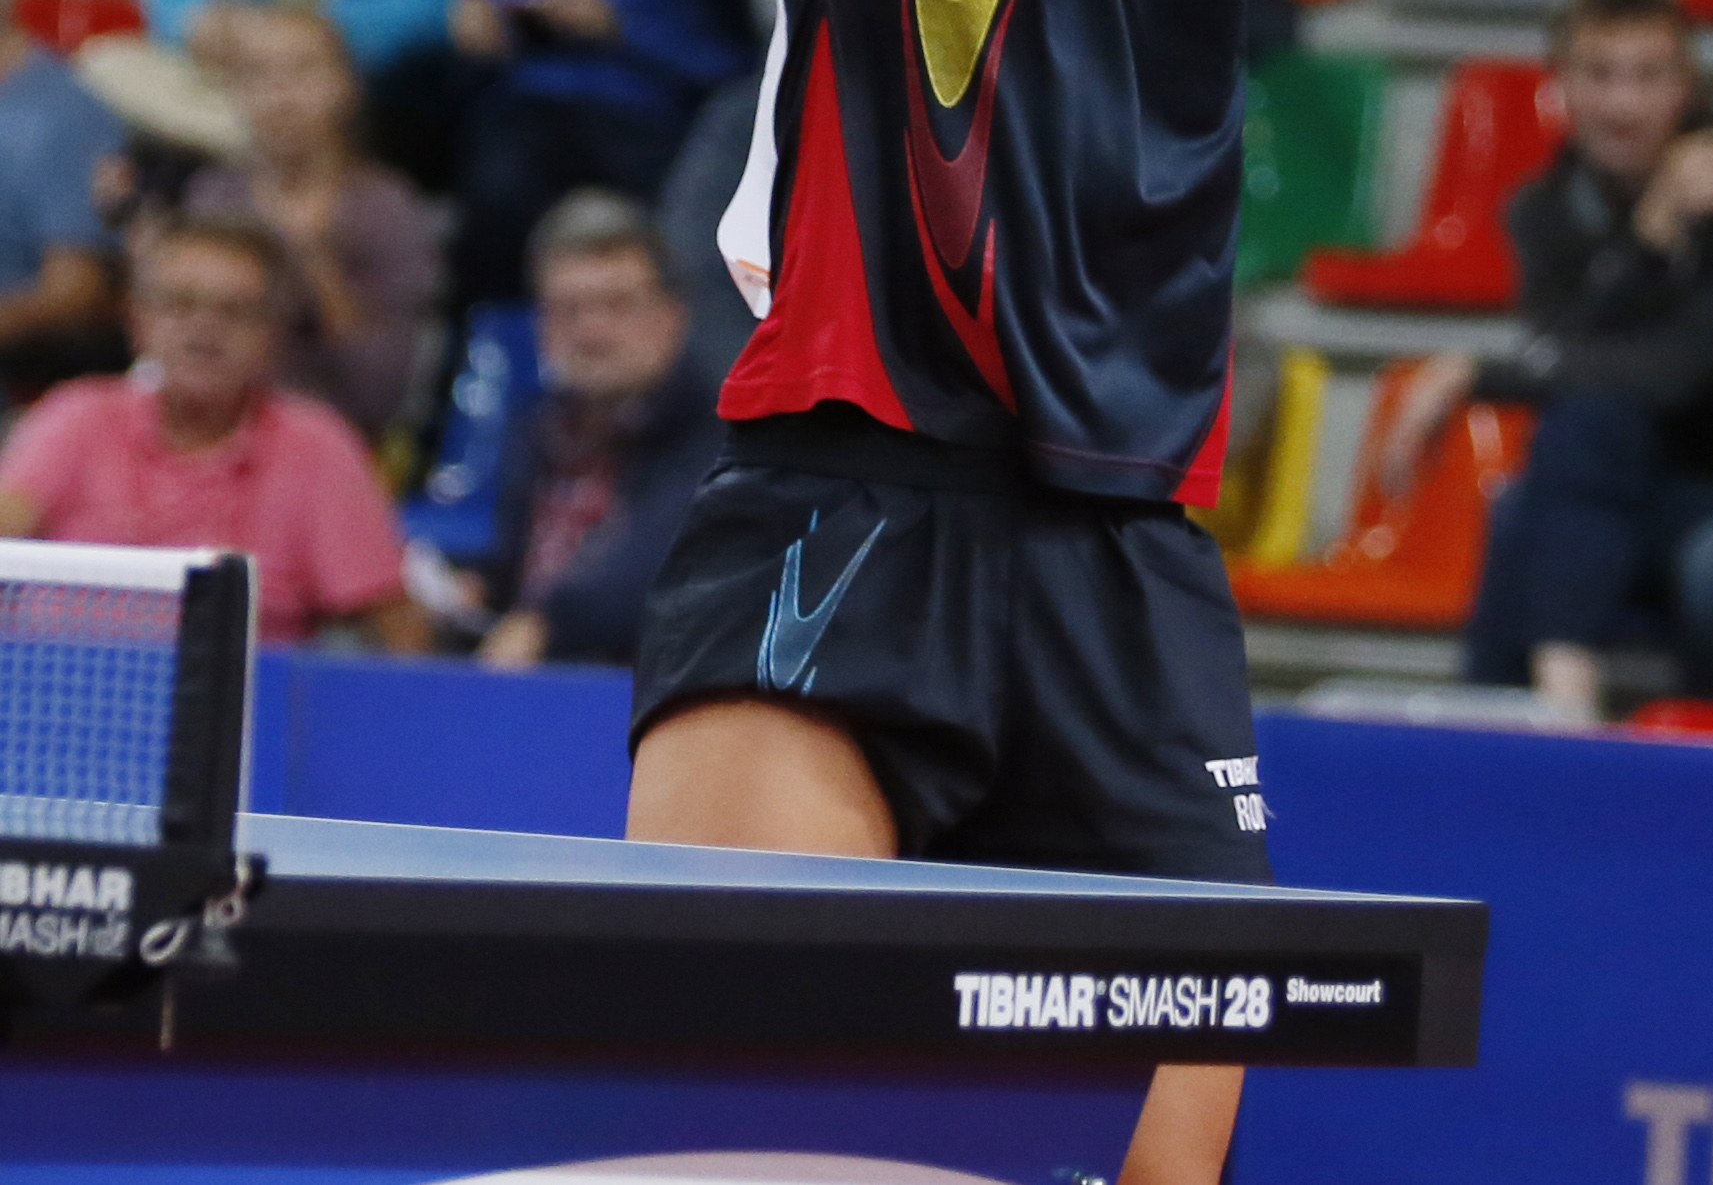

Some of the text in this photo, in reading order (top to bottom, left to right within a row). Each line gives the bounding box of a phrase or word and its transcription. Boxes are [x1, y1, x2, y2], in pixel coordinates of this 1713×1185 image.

[1107, 976, 1219, 1028] SMASH
[1223, 977, 1271, 1028] 28
[1286, 976, 1382, 1005] Showcourt
